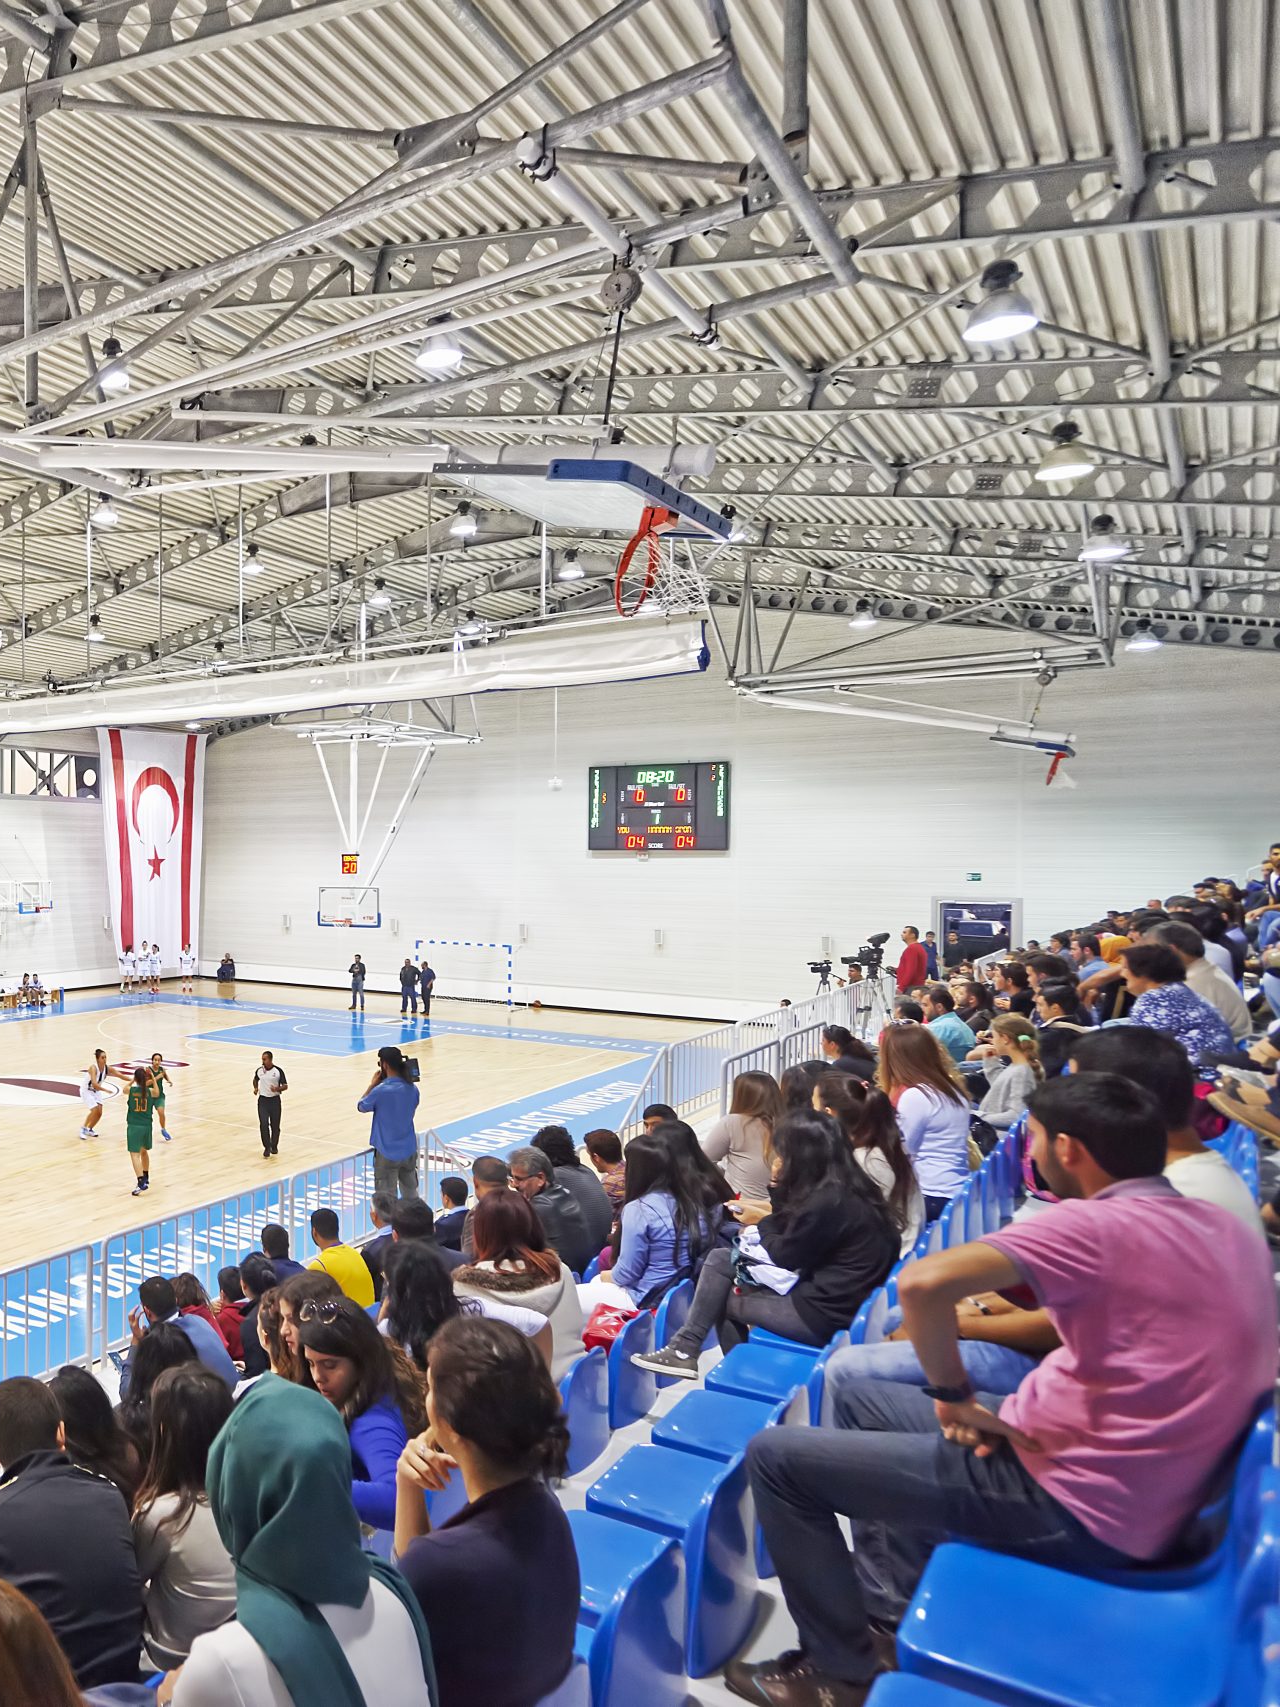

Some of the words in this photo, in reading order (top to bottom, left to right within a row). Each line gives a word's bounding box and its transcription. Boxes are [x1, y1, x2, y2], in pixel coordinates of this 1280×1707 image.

[637, 770, 675, 784] 08:20
[636, 789, 645, 802] 0
[677, 788, 686, 801] 0
[627, 836, 645, 848] 04
[676, 835, 694, 848] 04
[343, 862, 357, 873] 20
[445, 1128, 528, 1154] NEAR
[498, 1111, 576, 1138] EAST
